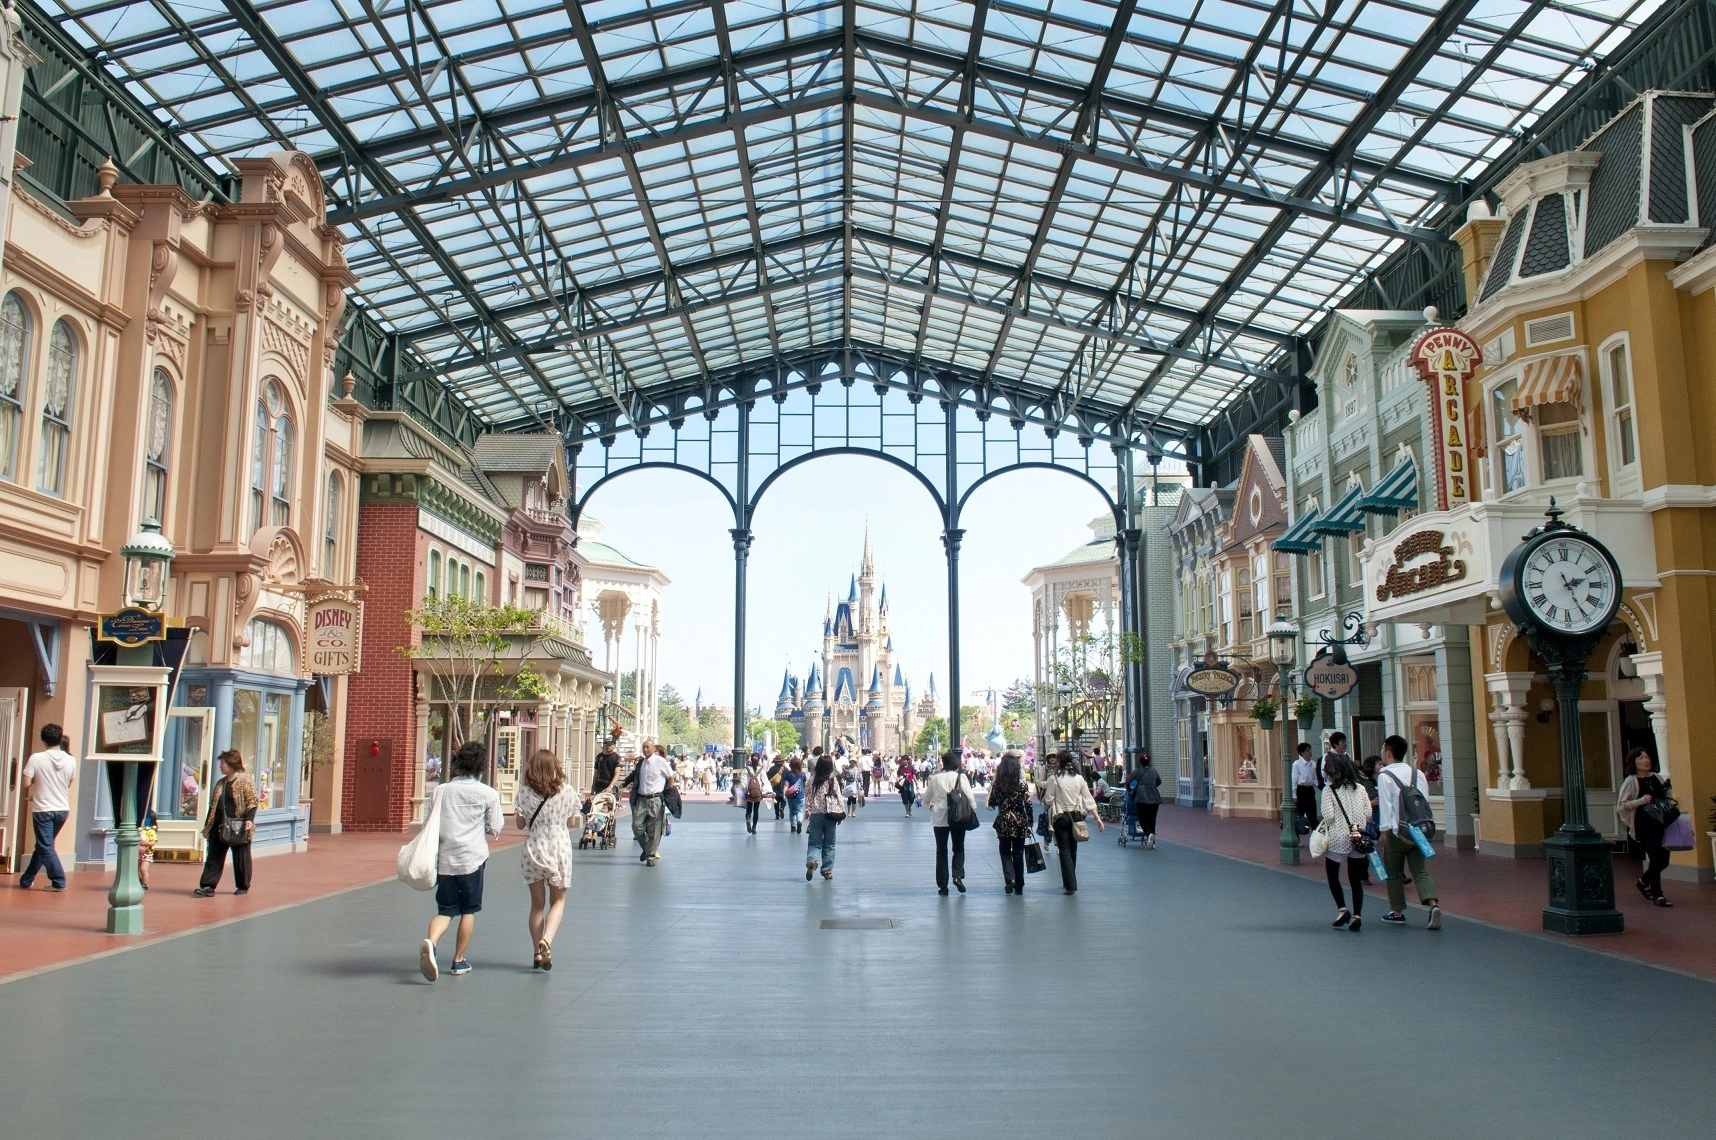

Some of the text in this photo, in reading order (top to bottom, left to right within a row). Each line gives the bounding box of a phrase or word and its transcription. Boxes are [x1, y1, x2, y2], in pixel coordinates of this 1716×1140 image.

[1425, 335, 1471, 353] PENNY
[1442, 350, 1465, 498] ARCADE
[1393, 530, 1445, 569] PENNY
[1376, 546, 1467, 602] ARCADE
[314, 608, 352, 631] DISNEY
[316, 639, 347, 647] CO.
[314, 651, 349, 666] GIFTS
[1313, 673, 1350, 685] HOKUSAI
